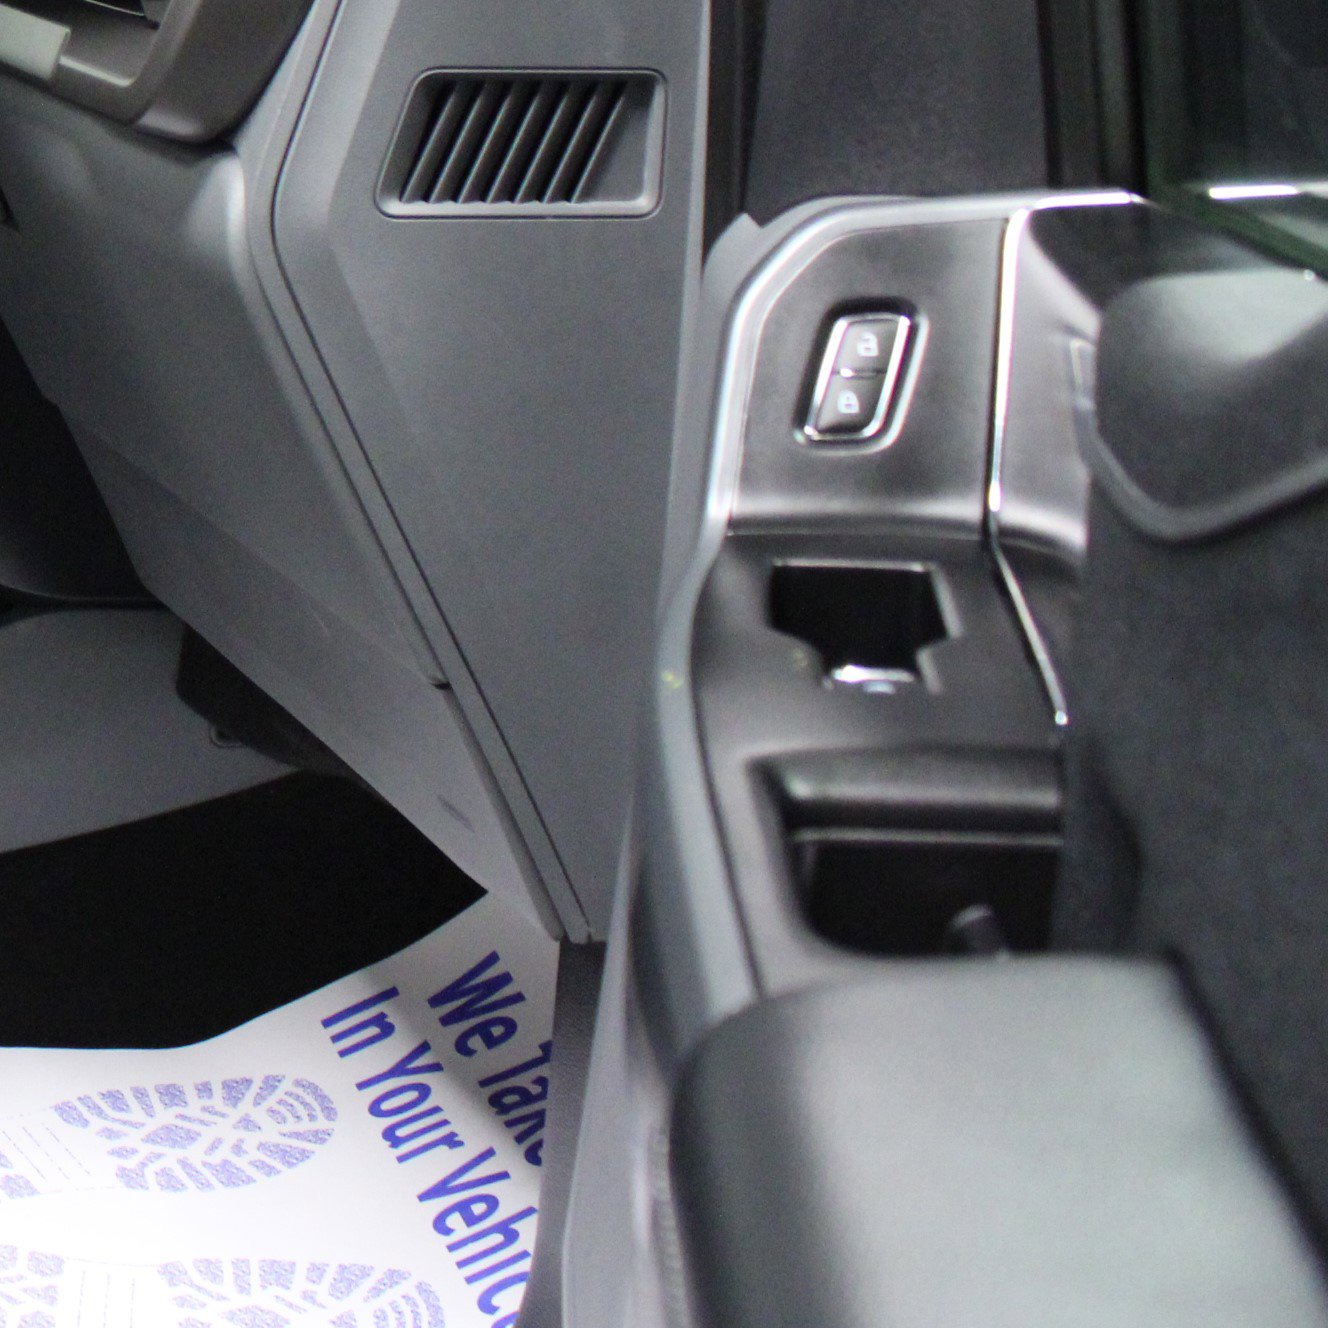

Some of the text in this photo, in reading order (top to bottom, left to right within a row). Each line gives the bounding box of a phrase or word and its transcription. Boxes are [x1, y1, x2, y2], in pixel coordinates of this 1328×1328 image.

[427, 950, 526, 1058] We
[321, 986, 539, 1328] In Your Vehic
